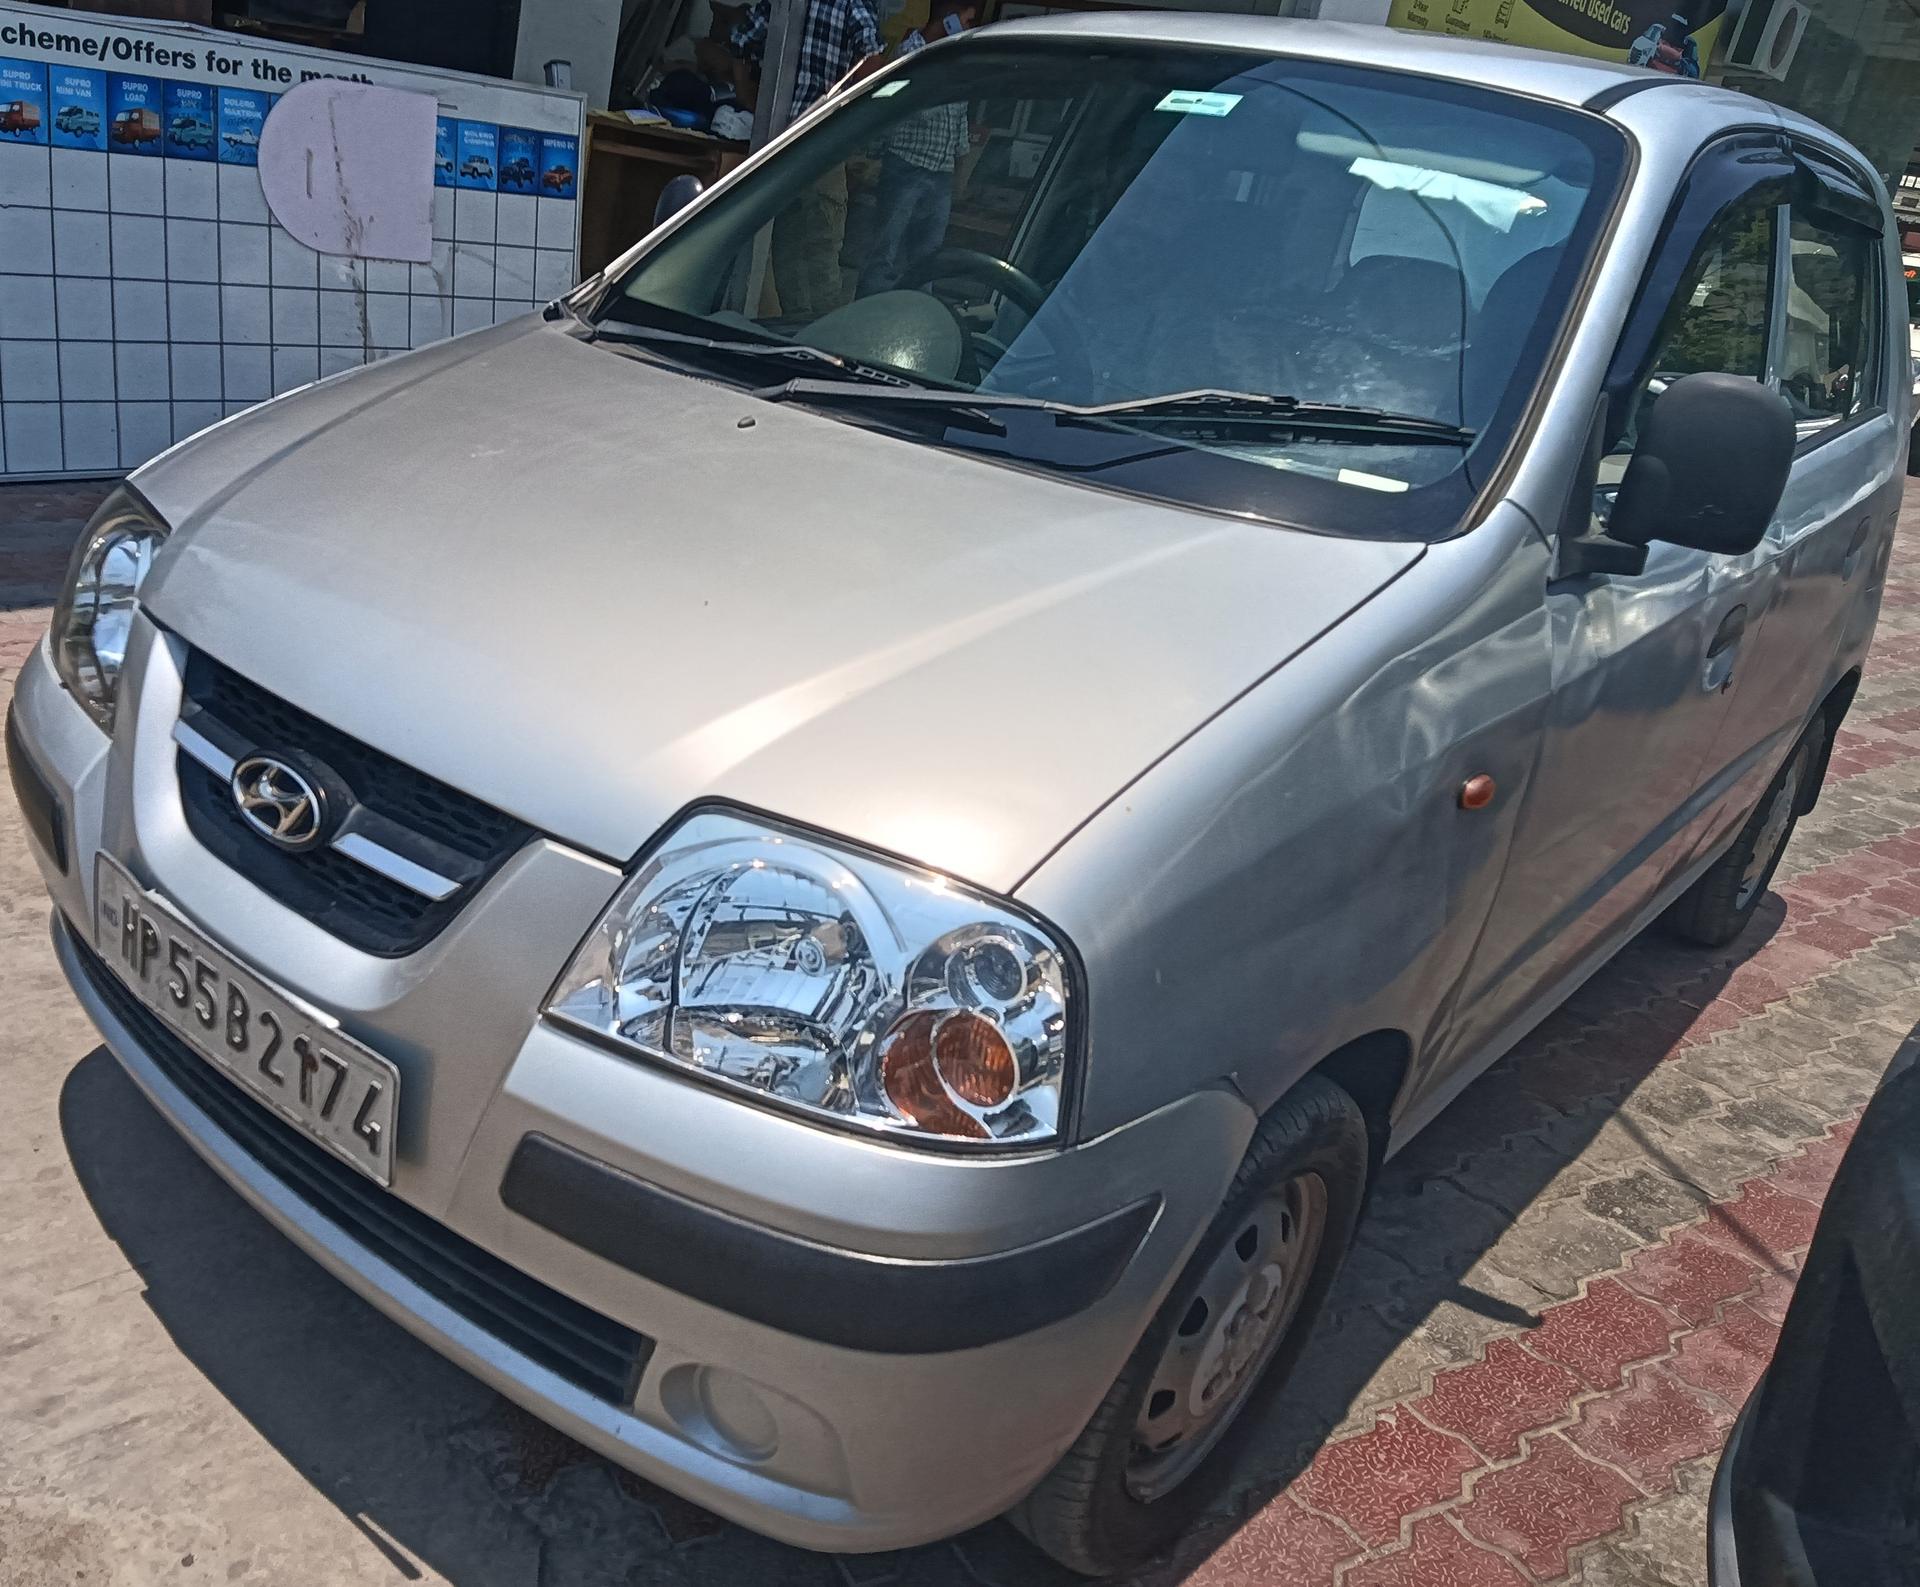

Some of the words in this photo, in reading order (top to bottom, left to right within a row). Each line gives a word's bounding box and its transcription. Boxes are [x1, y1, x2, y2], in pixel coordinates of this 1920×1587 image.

[1587, 0, 1614, 25] used
[1611, 10, 1632, 35] cars
[1, 22, 197, 69] cheme/Offers
[205, 50, 243, 76] for
[251, 58, 293, 84] the
[3, 69, 31, 80] SUPRO
[14, 81, 42, 92] TRUCK
[64, 77, 92, 88] SUPRO
[122, 81, 149, 92] SUPRO
[176, 88, 202, 99] SUPRO
